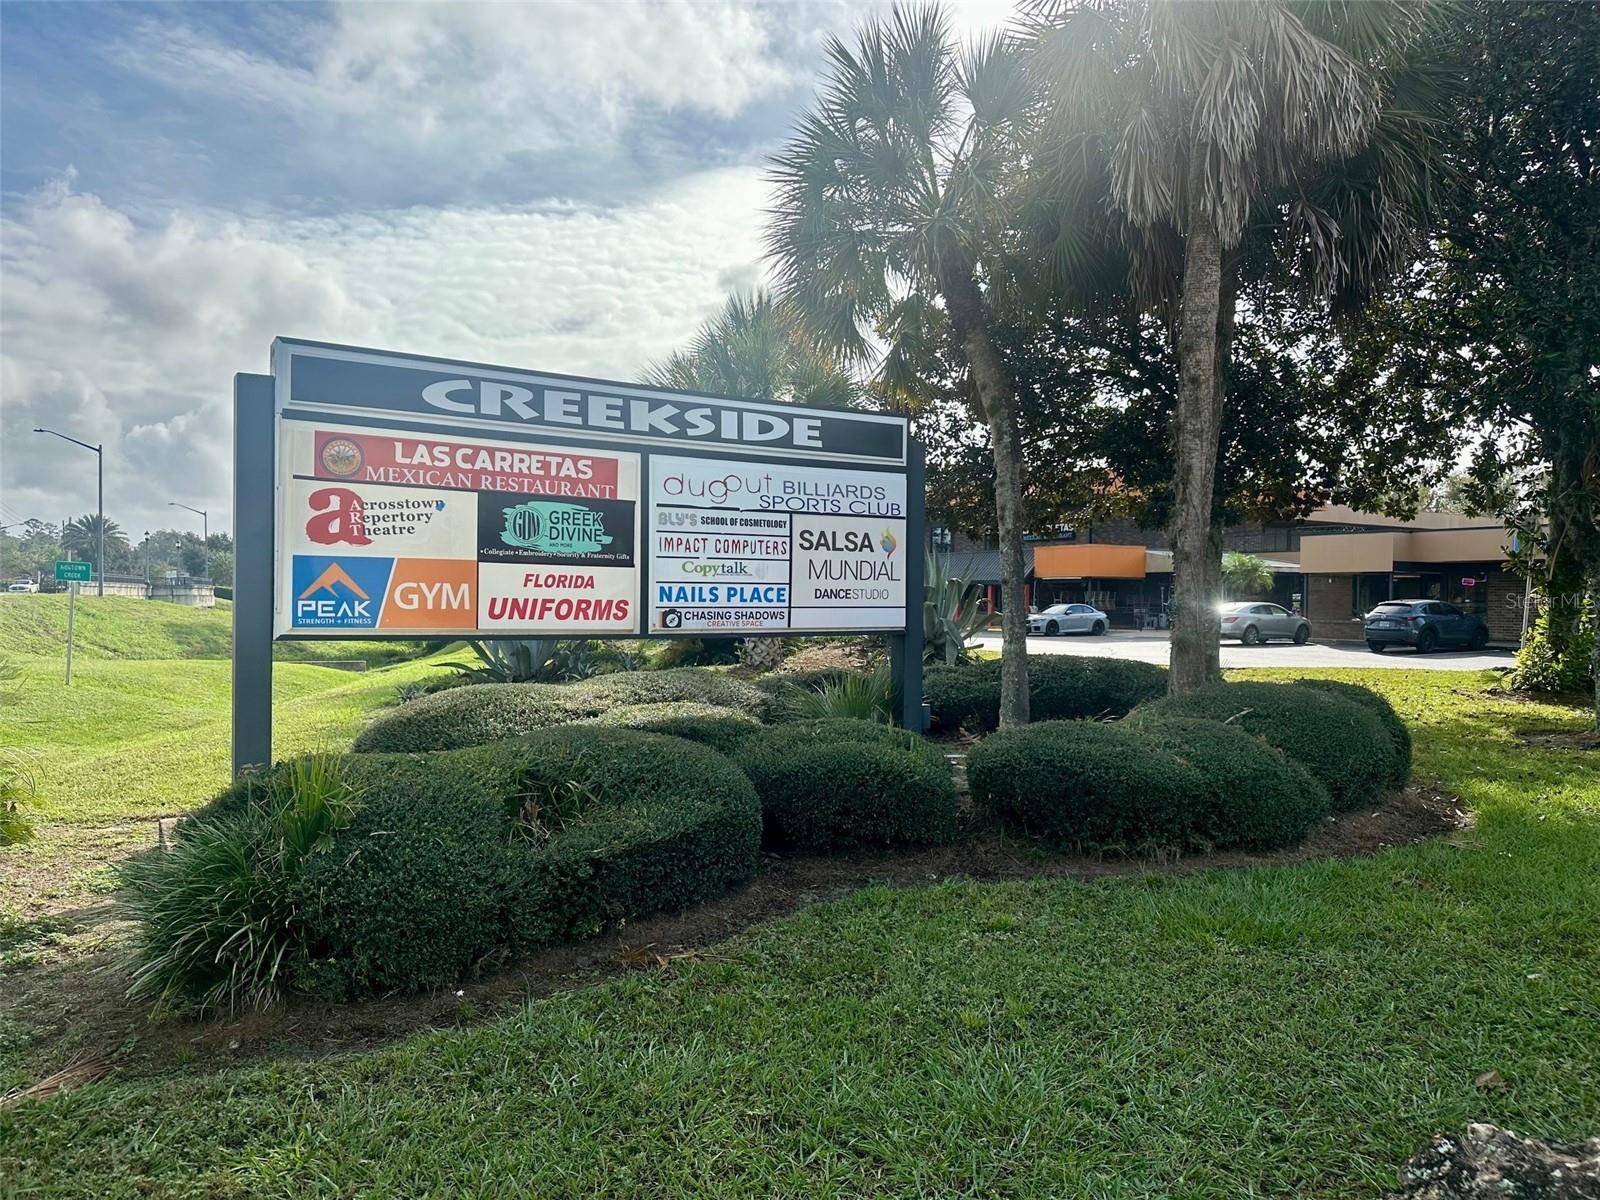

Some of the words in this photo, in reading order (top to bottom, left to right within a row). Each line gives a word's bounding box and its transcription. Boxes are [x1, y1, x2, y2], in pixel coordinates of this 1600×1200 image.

[421, 379, 824, 449] CREEKSIDE
[393, 441, 451, 466] LAS
[455, 449, 593, 479] CARRETAS
[366, 465, 473, 488] MEXICAN
[480, 476, 615, 499] RESTAURANT
[783, 480, 886, 500] BILLIARDS
[759, 495, 841, 512] SPORTS
[849, 501, 901, 516] CLUB
[350, 511, 433, 524] Repertory
[549, 510, 603, 527] GREEK
[700, 516, 728, 526] SCHOOL
[729, 517, 738, 527] OF
[739, 518, 787, 529] COSMETOLOGY
[350, 523, 416, 537] Theatre
[549, 526, 602, 543] DIVINE
[658, 537, 709, 553] IMPACT
[714, 538, 788, 555] COMPUTERS
[799, 529, 875, 554] SALSA
[483, 547, 514, 556] Collegiate
[518, 550, 553, 558] Embroidery
[556, 551, 580, 560] Sorority
[587, 552, 615, 560] Fraternity
[681, 560, 749, 577] Copytalk
[808, 558, 901, 582] MUNDIAL
[523, 573, 595, 590] FLORIDA
[393, 581, 472, 611] GYM
[659, 585, 720, 603] NAILS
[726, 586, 787, 603] PLACE
[297, 600, 371, 617] PEAK
[487, 597, 630, 621] UNIFORMS
[683, 610, 732, 621] CHASING
[734, 611, 785, 621] SHADOWS
[297, 617, 335, 625] STRENGTH
